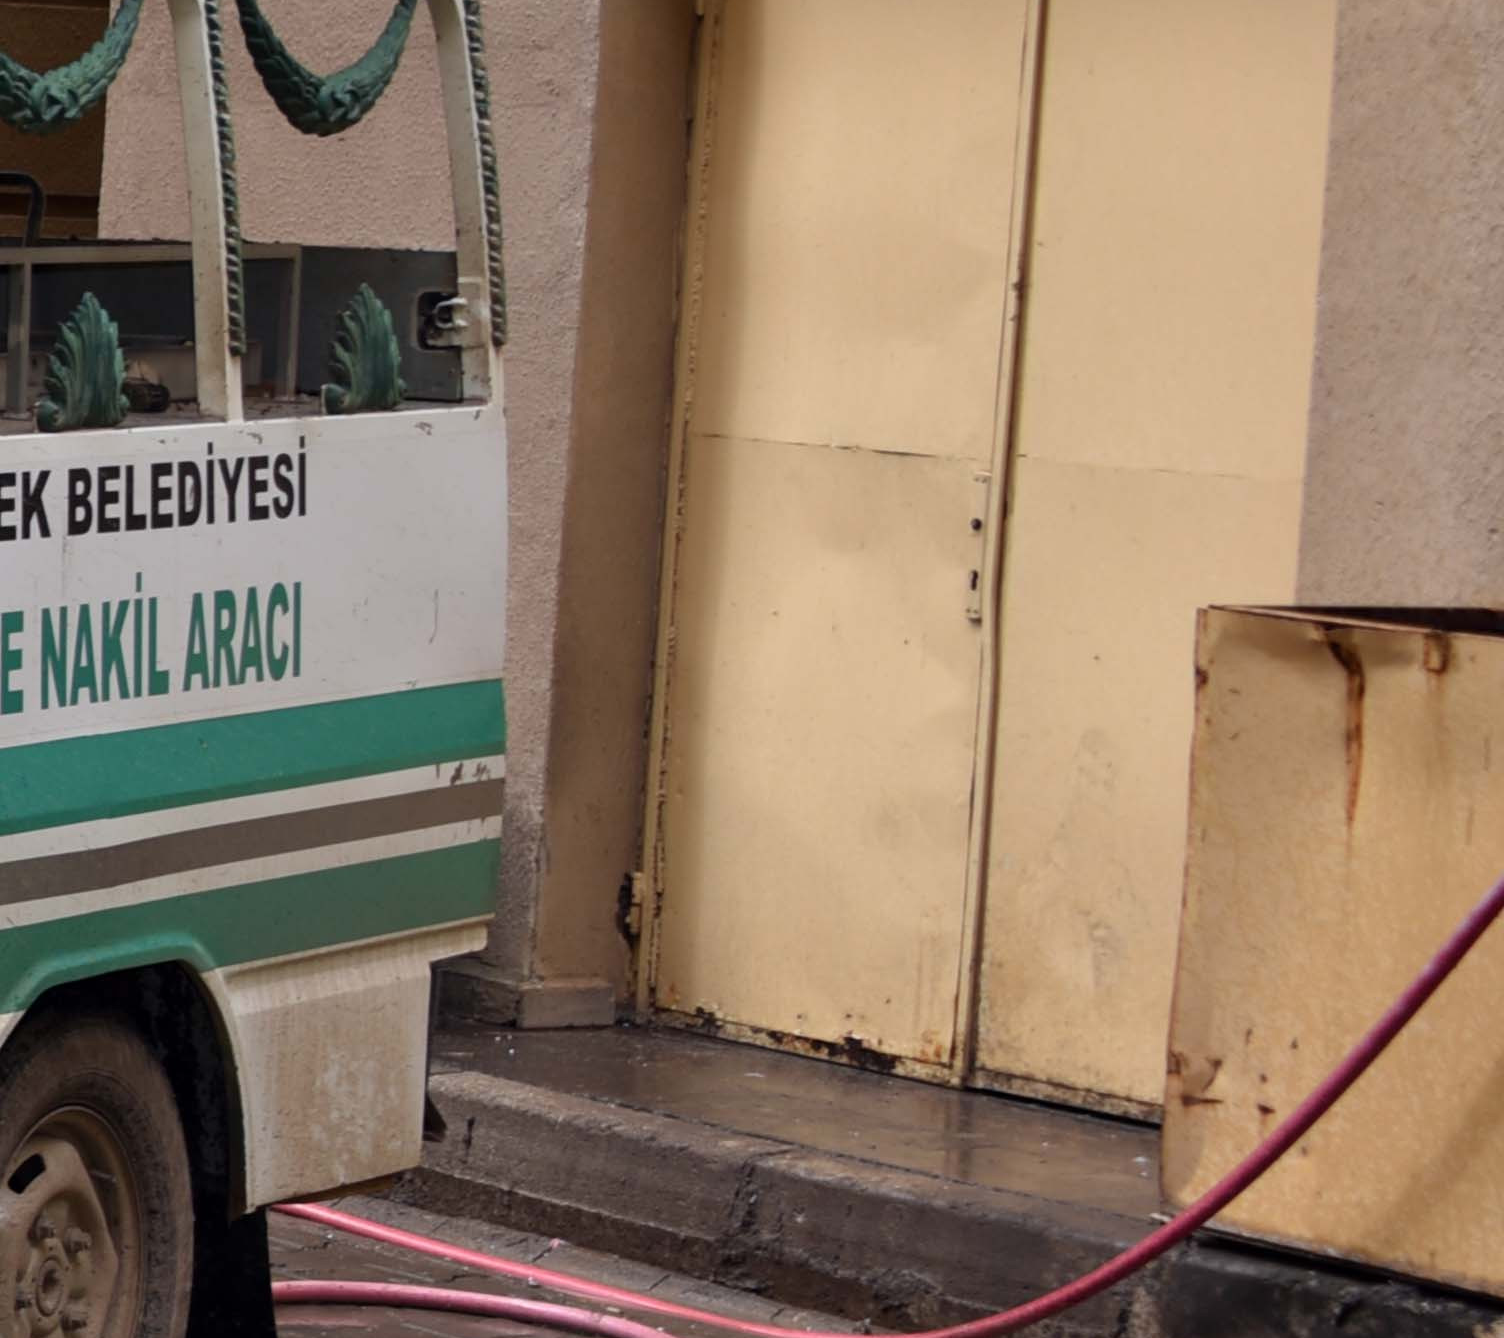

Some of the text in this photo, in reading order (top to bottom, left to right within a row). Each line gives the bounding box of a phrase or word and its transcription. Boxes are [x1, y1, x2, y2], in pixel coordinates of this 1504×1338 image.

[66, 435, 308, 537] BELEDİYESİ
[40, 571, 170, 710] NAKİL
[182, 581, 302, 692] ARACI
